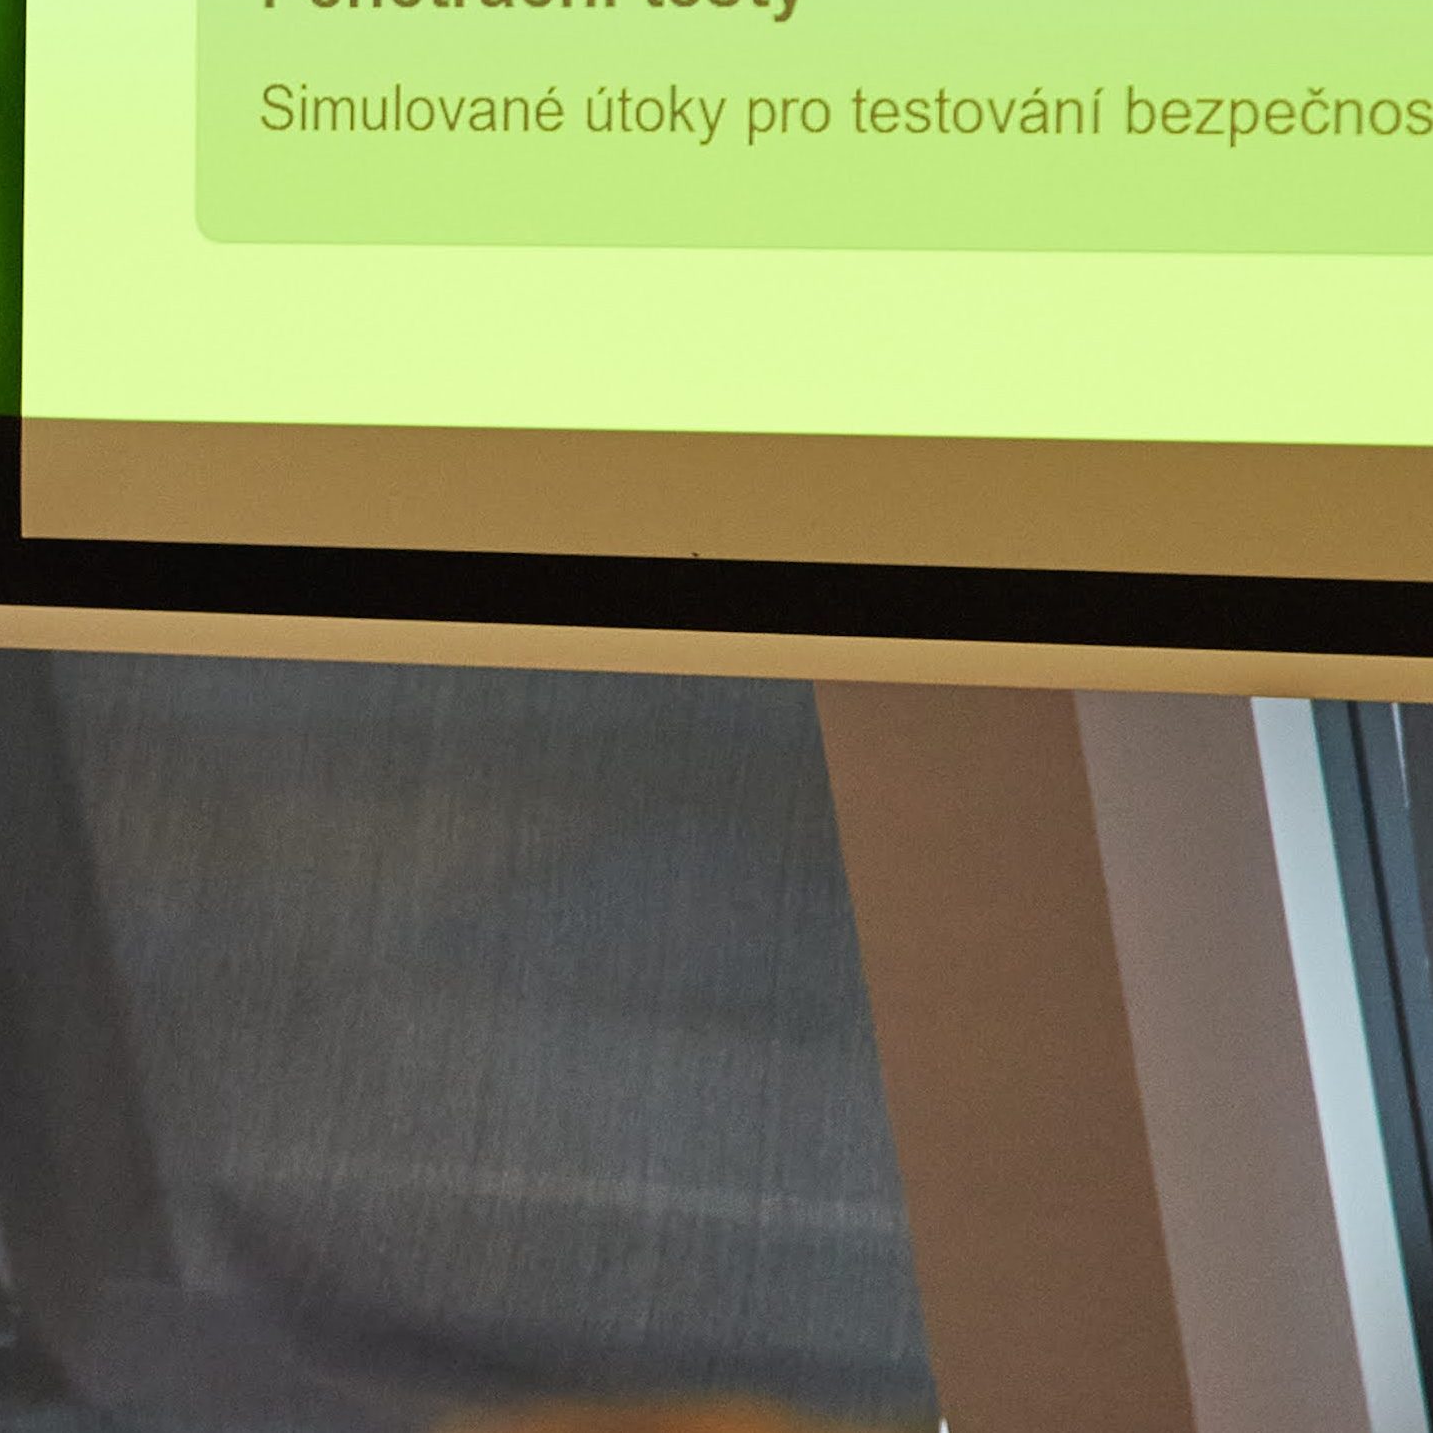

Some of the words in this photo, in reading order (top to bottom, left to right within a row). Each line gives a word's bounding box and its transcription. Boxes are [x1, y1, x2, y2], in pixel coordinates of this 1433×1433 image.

[262, 84, 563, 131] Simulované
[587, 85, 726, 145] útoky
[749, 98, 830, 146] pro
[852, 87, 1103, 134] testování
[1127, 84, 1433, 148] bezpečnos
